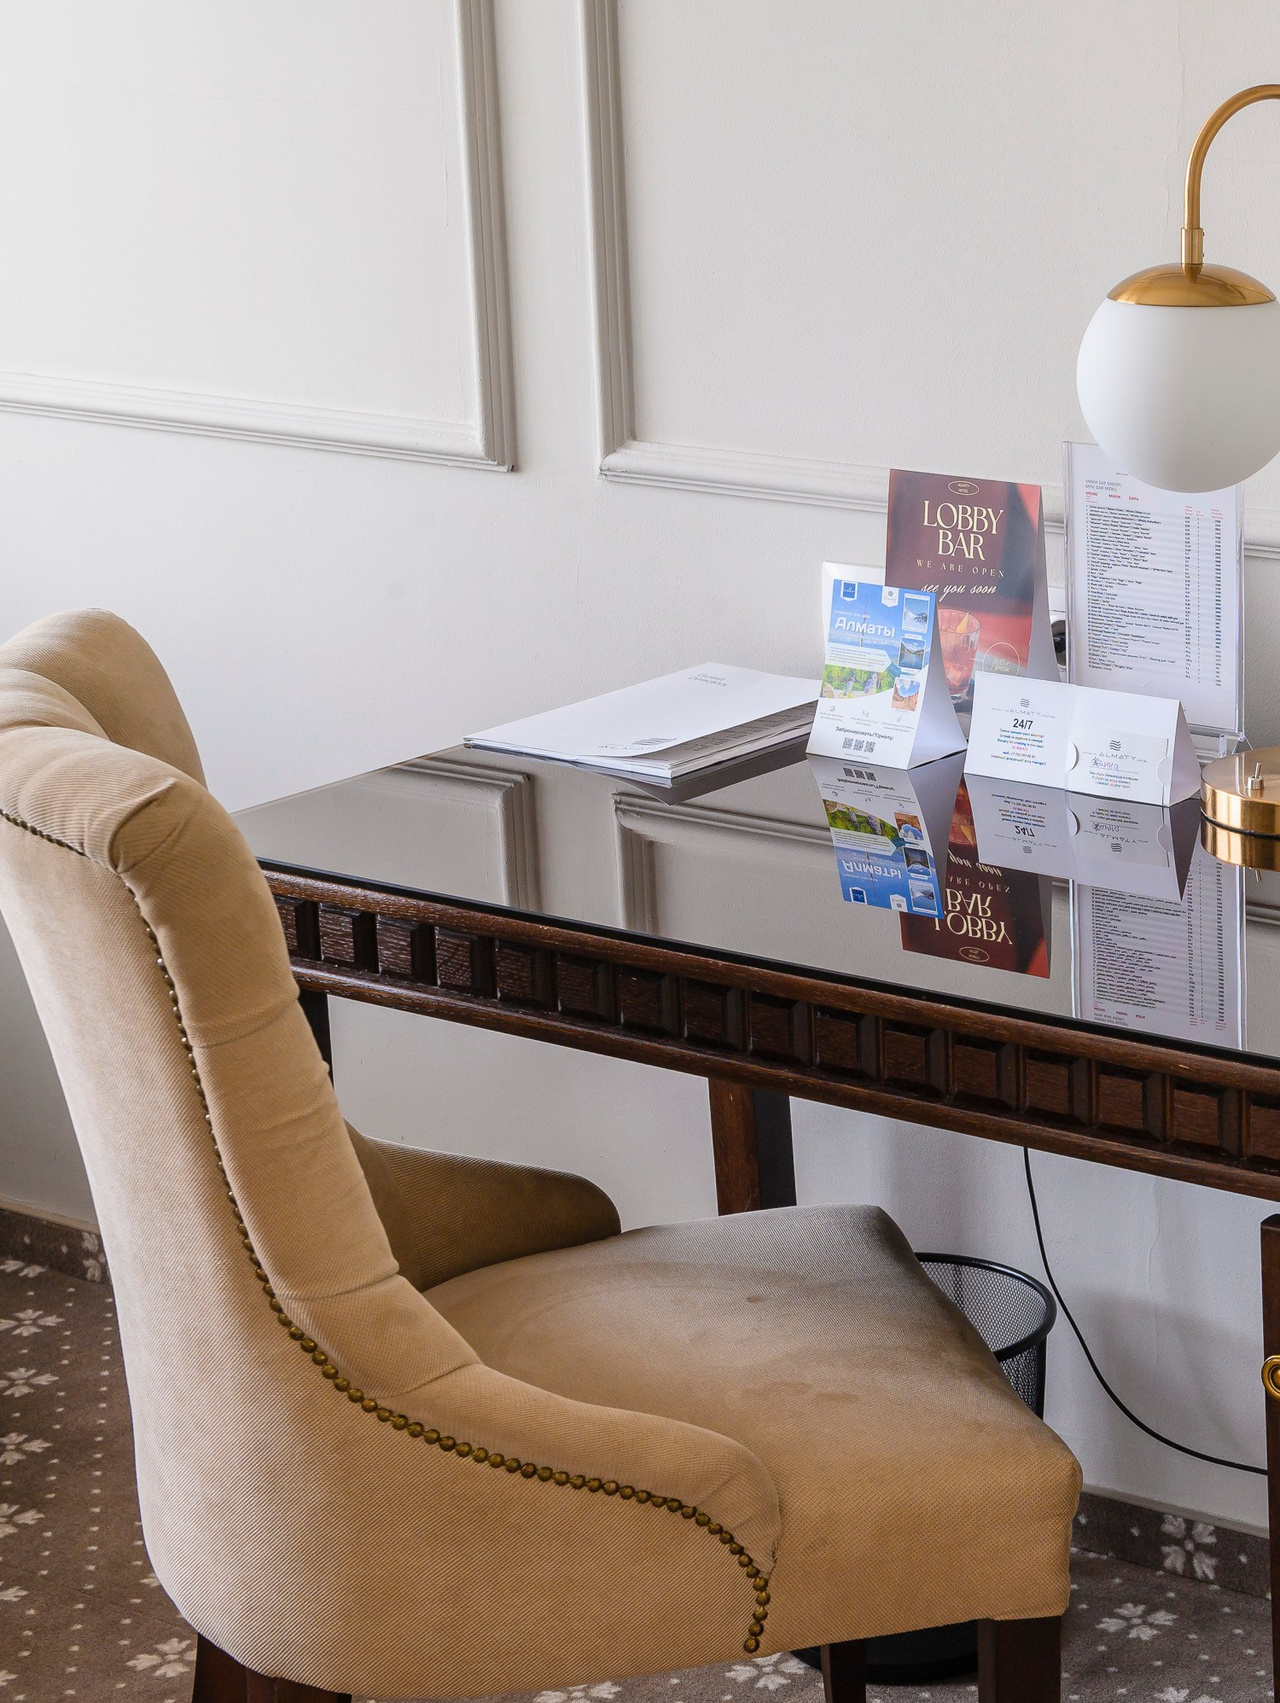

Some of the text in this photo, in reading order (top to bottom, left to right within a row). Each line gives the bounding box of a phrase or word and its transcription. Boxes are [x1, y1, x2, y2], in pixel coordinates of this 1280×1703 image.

[923, 500, 1004, 535] LOBBY
[938, 529, 985, 560] BAR
[916, 559, 1005, 578] WE ARE OPEN
[921, 584, 939, 593] see
[939, 584, 966, 603] you
[970, 584, 997, 594] soon
[834, 616, 896, 638] Алматы
[1010, 708, 1040, 716] ALMATY
[1013, 718, 1033, 730] 24/7
[1099, 752, 1136, 760] ALMATY
